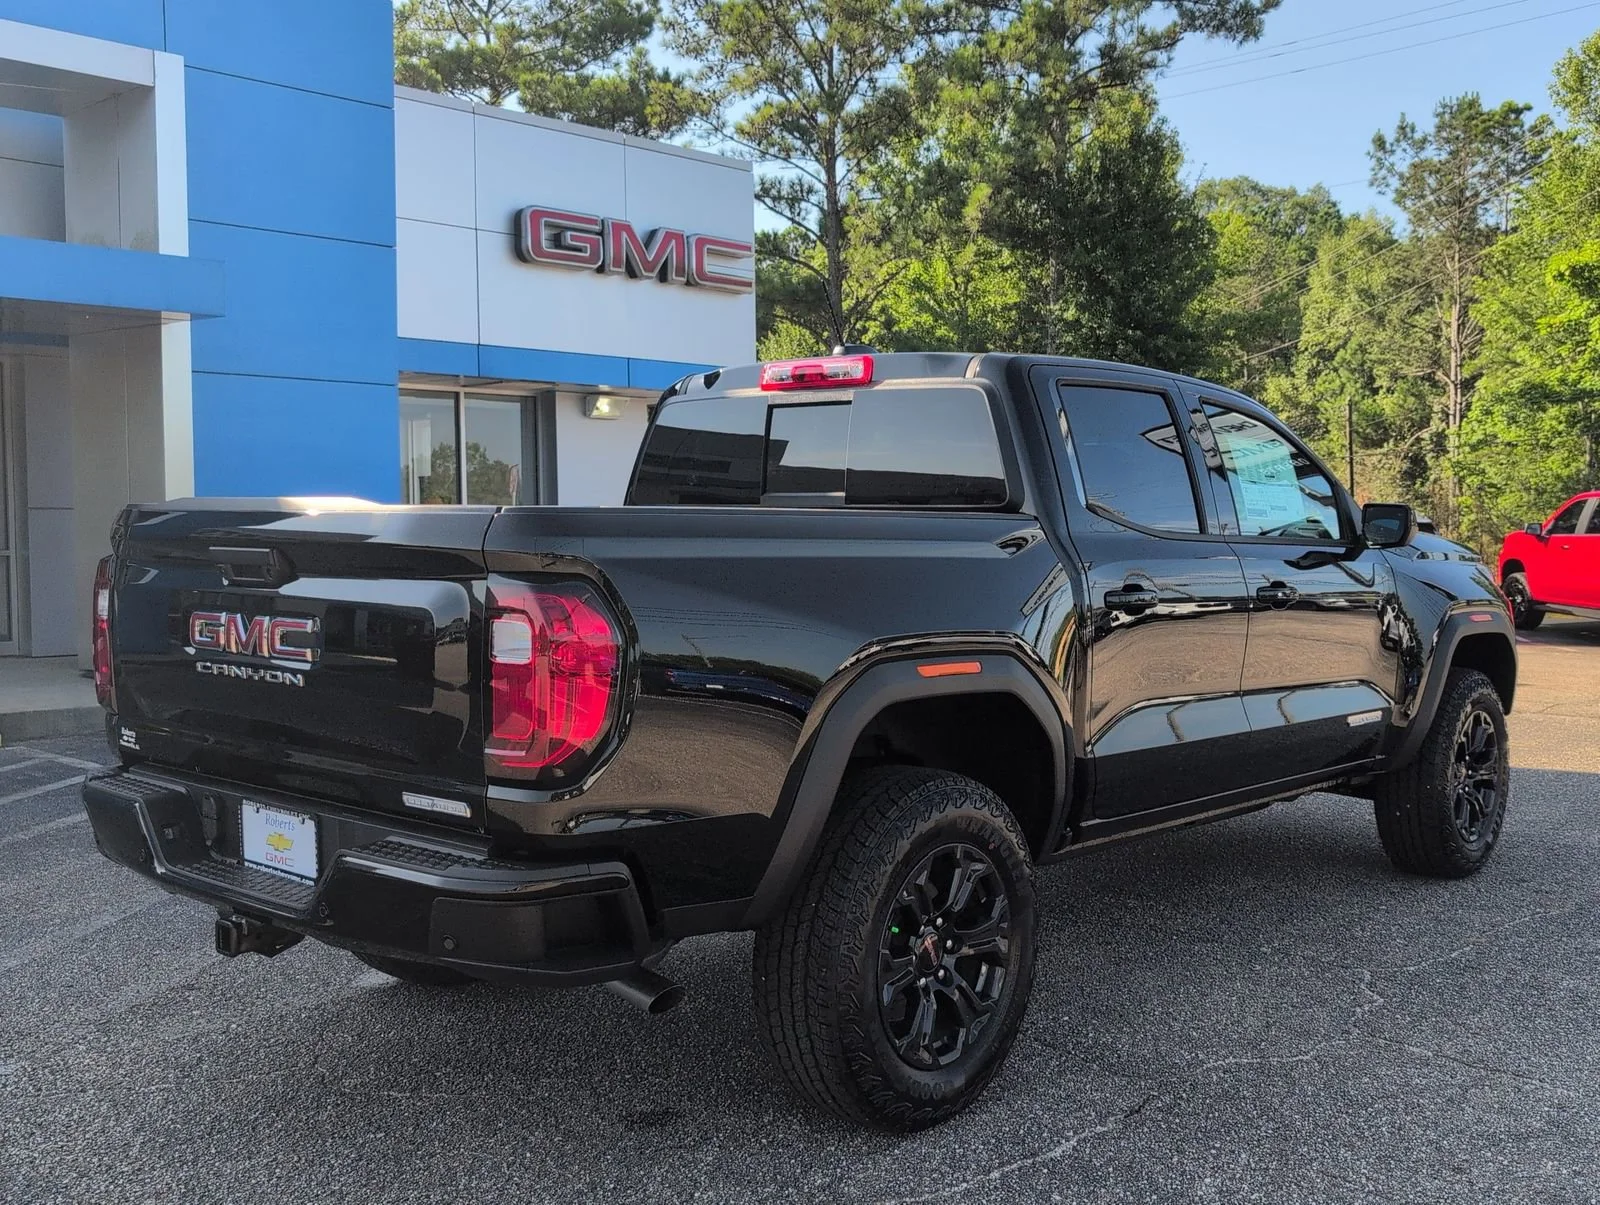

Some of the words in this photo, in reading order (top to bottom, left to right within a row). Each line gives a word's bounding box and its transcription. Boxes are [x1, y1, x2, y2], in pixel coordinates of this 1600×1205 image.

[515, 205, 755, 294] GMC
[189, 611, 320, 662] GMC
[195, 661, 306, 687] CANYON
[265, 813, 295, 831] Roberts
[265, 852, 295, 867] GMC
